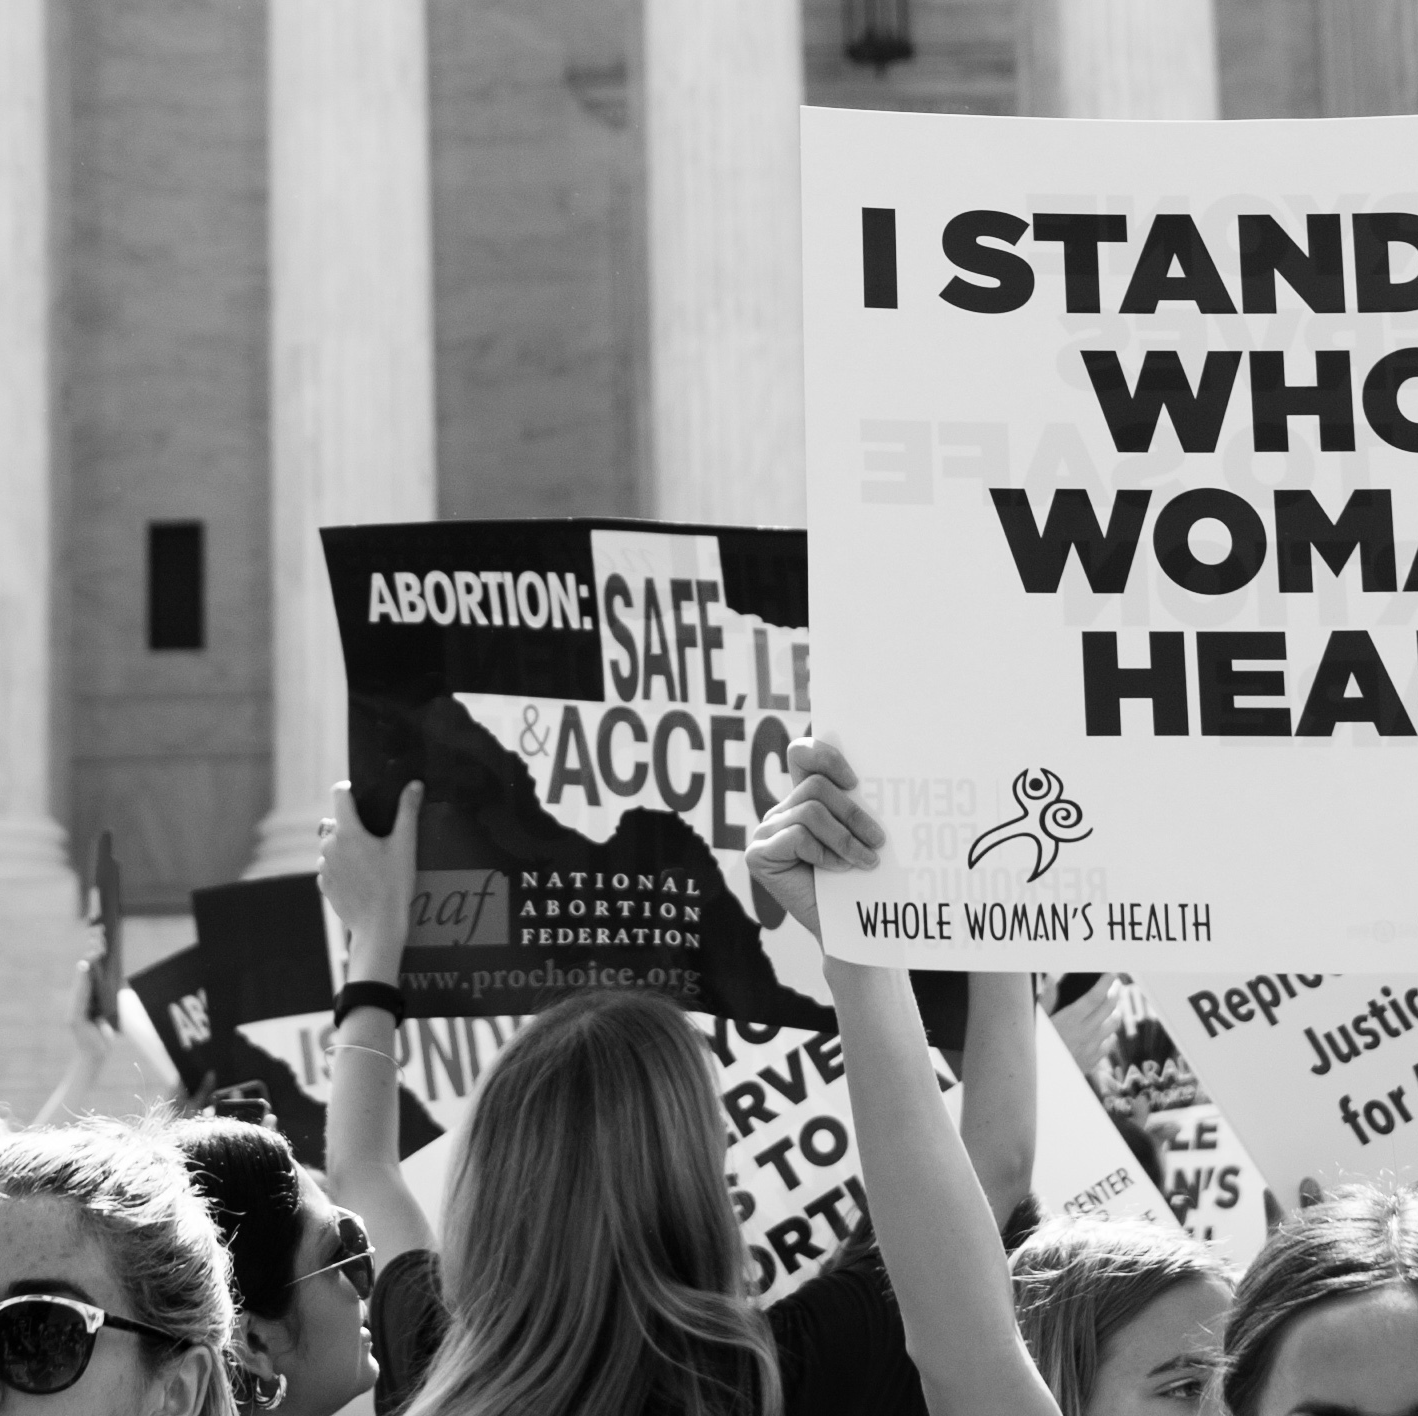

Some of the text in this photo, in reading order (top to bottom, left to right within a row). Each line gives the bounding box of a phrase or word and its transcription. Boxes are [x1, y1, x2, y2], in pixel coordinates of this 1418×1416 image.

[861, 207, 898, 310] I
[368, 570, 593, 631] ABORTION:
[603, 572, 748, 711] SAFE,
[519, 703, 551, 757] &
[519, 899, 701, 923] ABORTION
[520, 870, 701, 896] NATIONAL
[520, 928, 701, 949] FEDERATION
[856, 900, 1211, 942] WHOLE WOMAN'S HEALTH
[1338, 1084, 1414, 1146] for
[753, 1114, 849, 1192] TO
